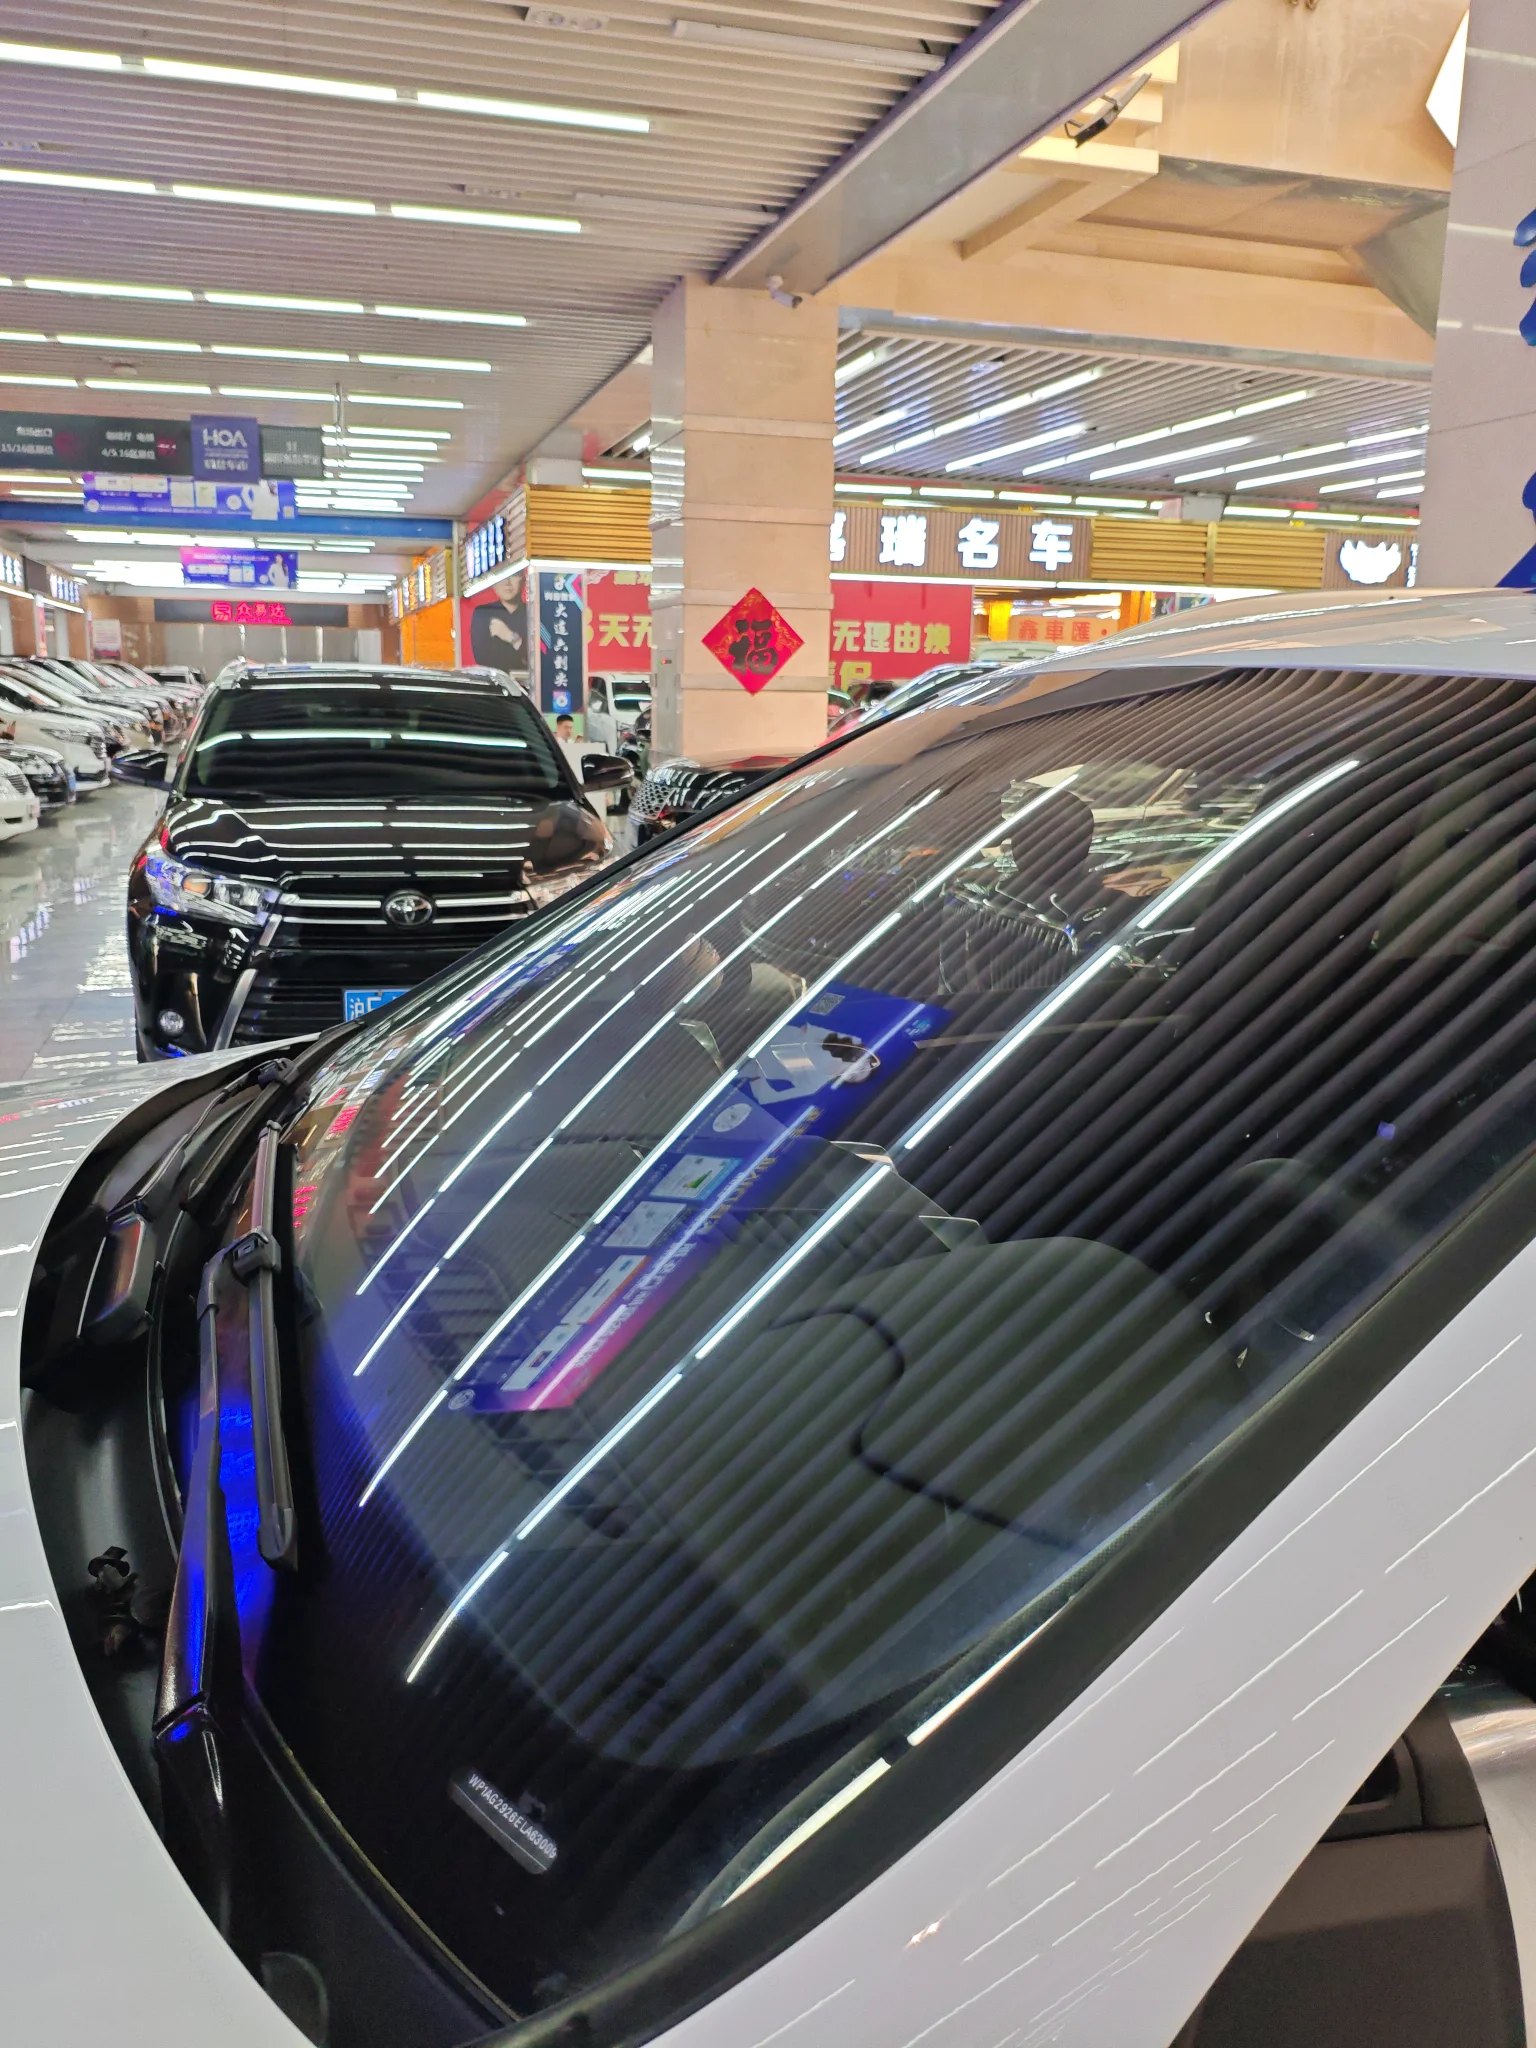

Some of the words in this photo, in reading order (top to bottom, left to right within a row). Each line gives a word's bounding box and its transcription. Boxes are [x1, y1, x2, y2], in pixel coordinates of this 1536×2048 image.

[202, 428, 248, 448] HOA
[832, 620, 951, 654] 无理由换
[1018, 619, 1091, 643] 鑫車匯
[728, 618, 779, 676] 福
